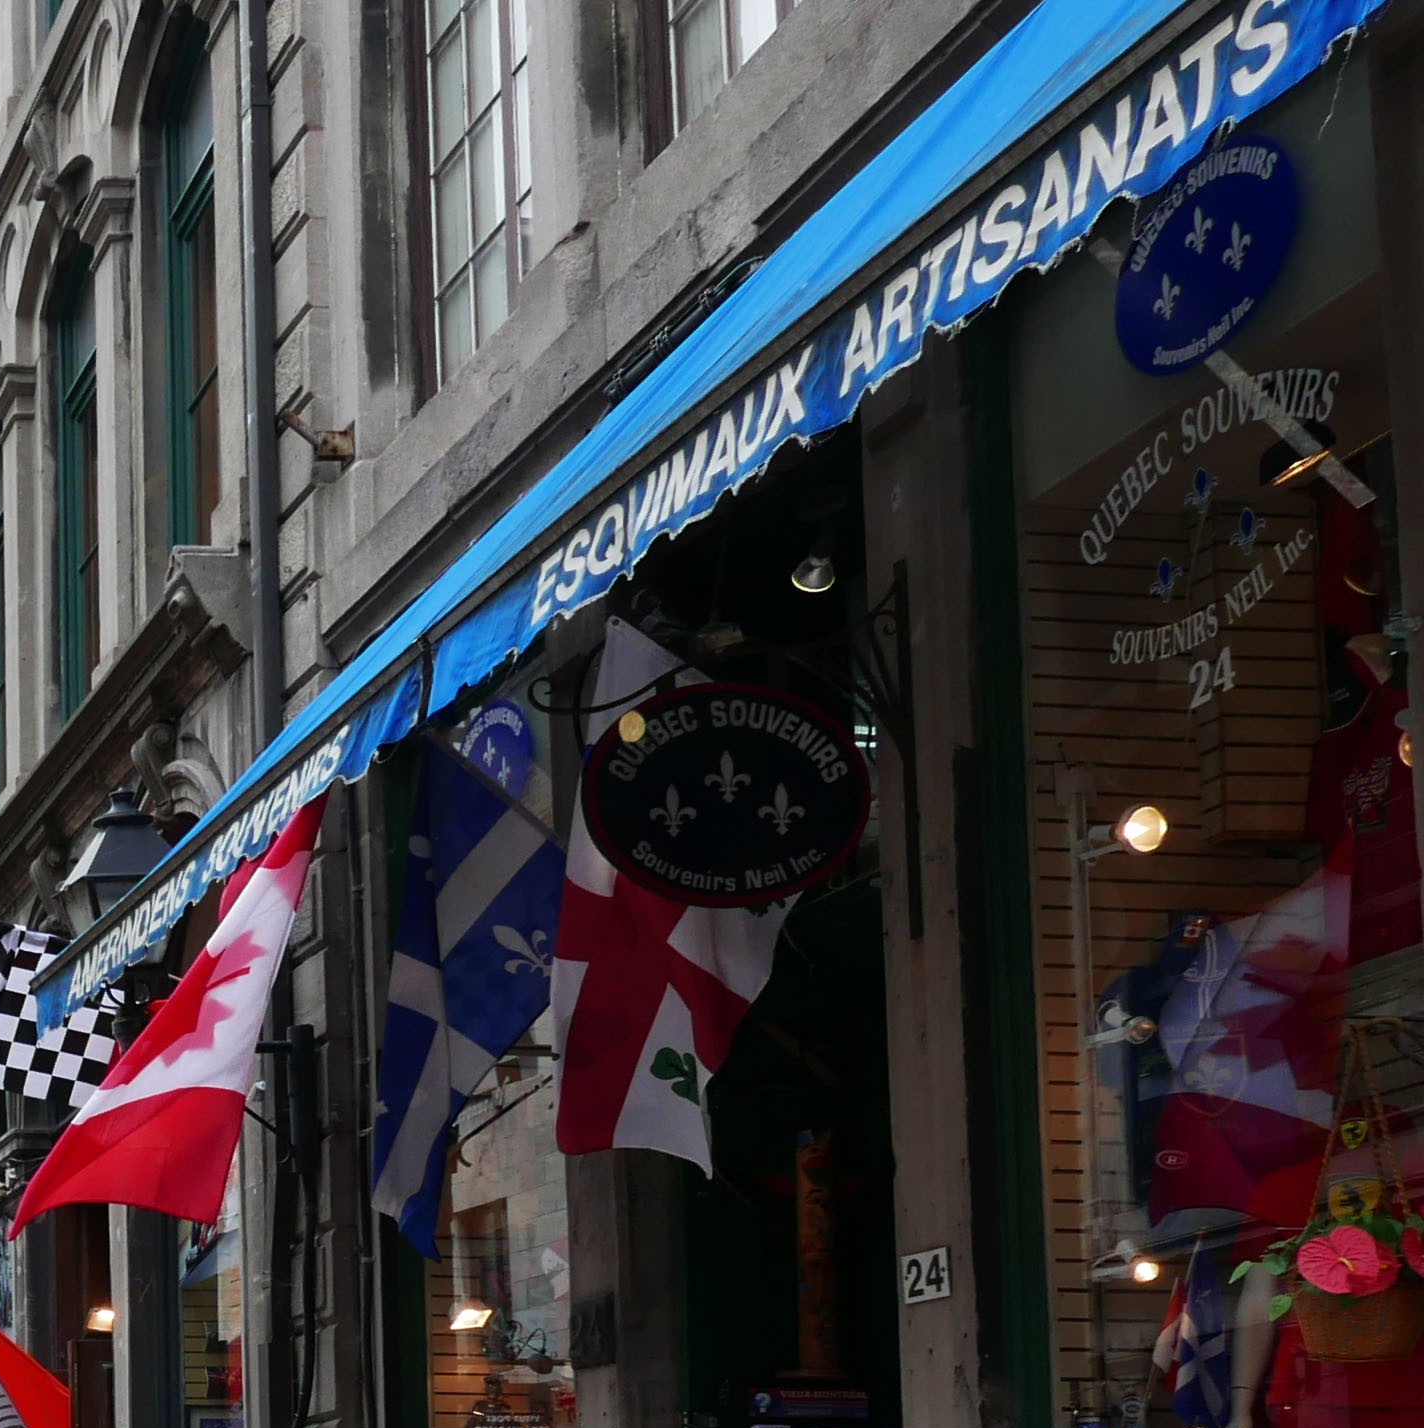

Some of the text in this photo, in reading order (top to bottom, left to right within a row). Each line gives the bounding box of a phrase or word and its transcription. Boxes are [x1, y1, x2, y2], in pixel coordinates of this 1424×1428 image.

[841, 0, 1292, 398] ARTISANATS
[1186, 146, 1279, 195] SOUVENIRS
[1153, 336, 1208, 367] Souvenirs
[1207, 314, 1233, 348] Neil
[1080, 368, 1341, 566] QUEBEC SOUVENIRS
[1109, 526, 1316, 665] SOUVENIRS NEIL Inc.
[1188, 646, 1237, 711] 24
[608, 699, 850, 785] QUEBEC SOUVENIRS
[631, 840, 830, 892] Souvenirs Neil Inc.
[906, 1253, 945, 1298] 24
